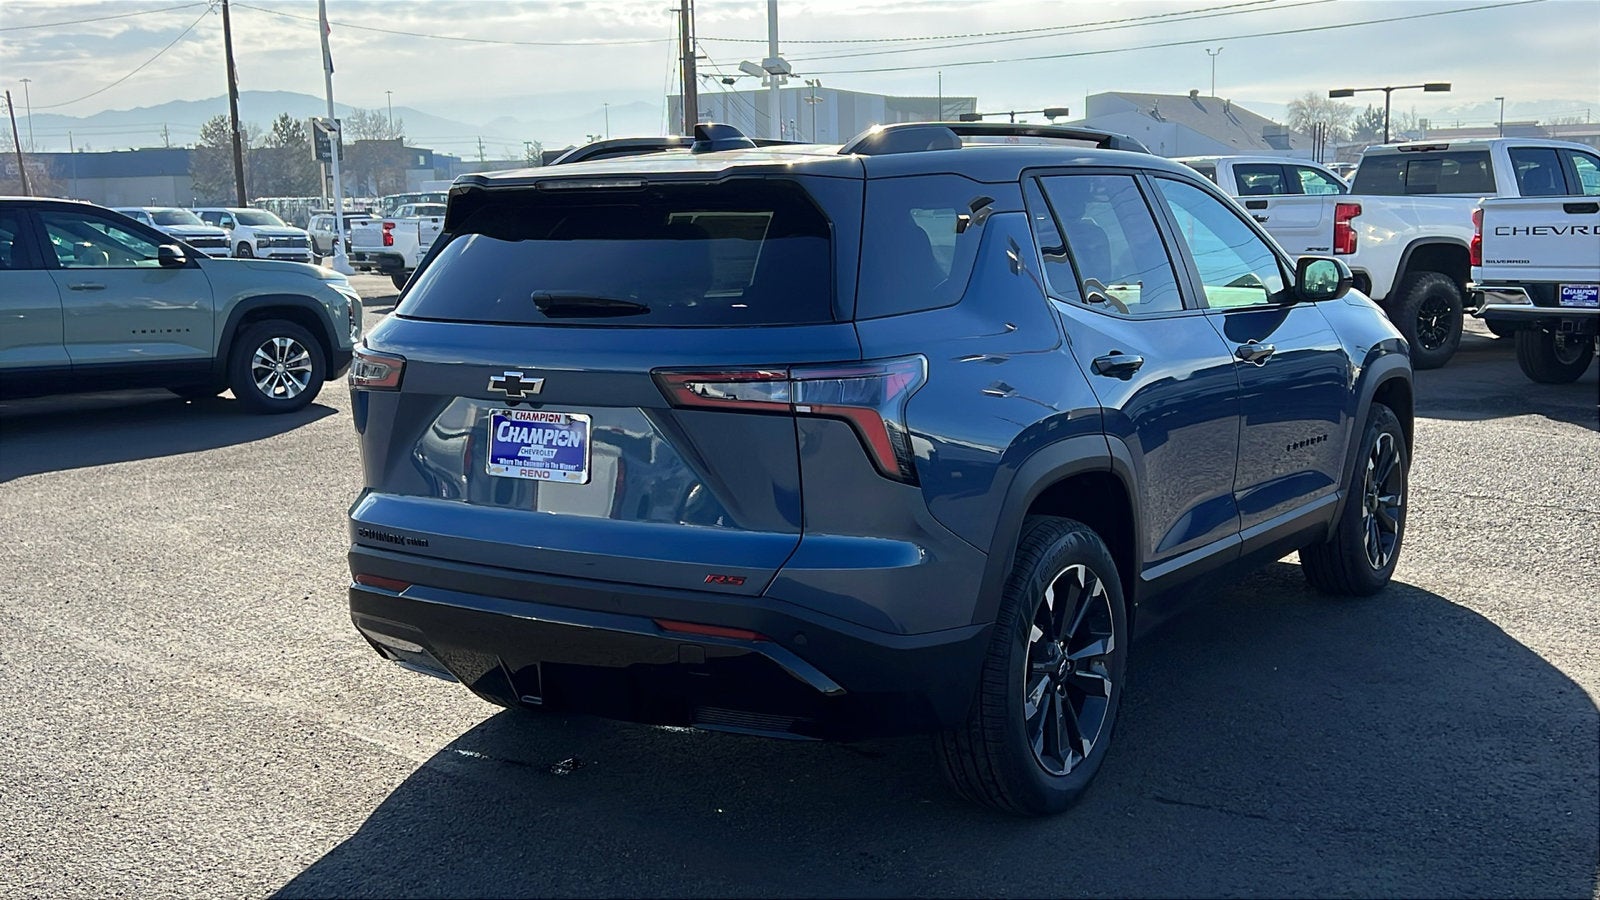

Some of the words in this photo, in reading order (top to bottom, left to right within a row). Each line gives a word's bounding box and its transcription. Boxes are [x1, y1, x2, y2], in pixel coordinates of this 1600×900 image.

[1562, 287, 1598, 296] CHAMPION
[515, 411, 562, 423] CHAMPION
[496, 421, 581, 448] CHAMPION
[520, 448, 554, 457] CHEVROLET
[520, 468, 551, 479] RENO
[358, 527, 405, 545] EQUINOX
[704, 574, 747, 586] RS
